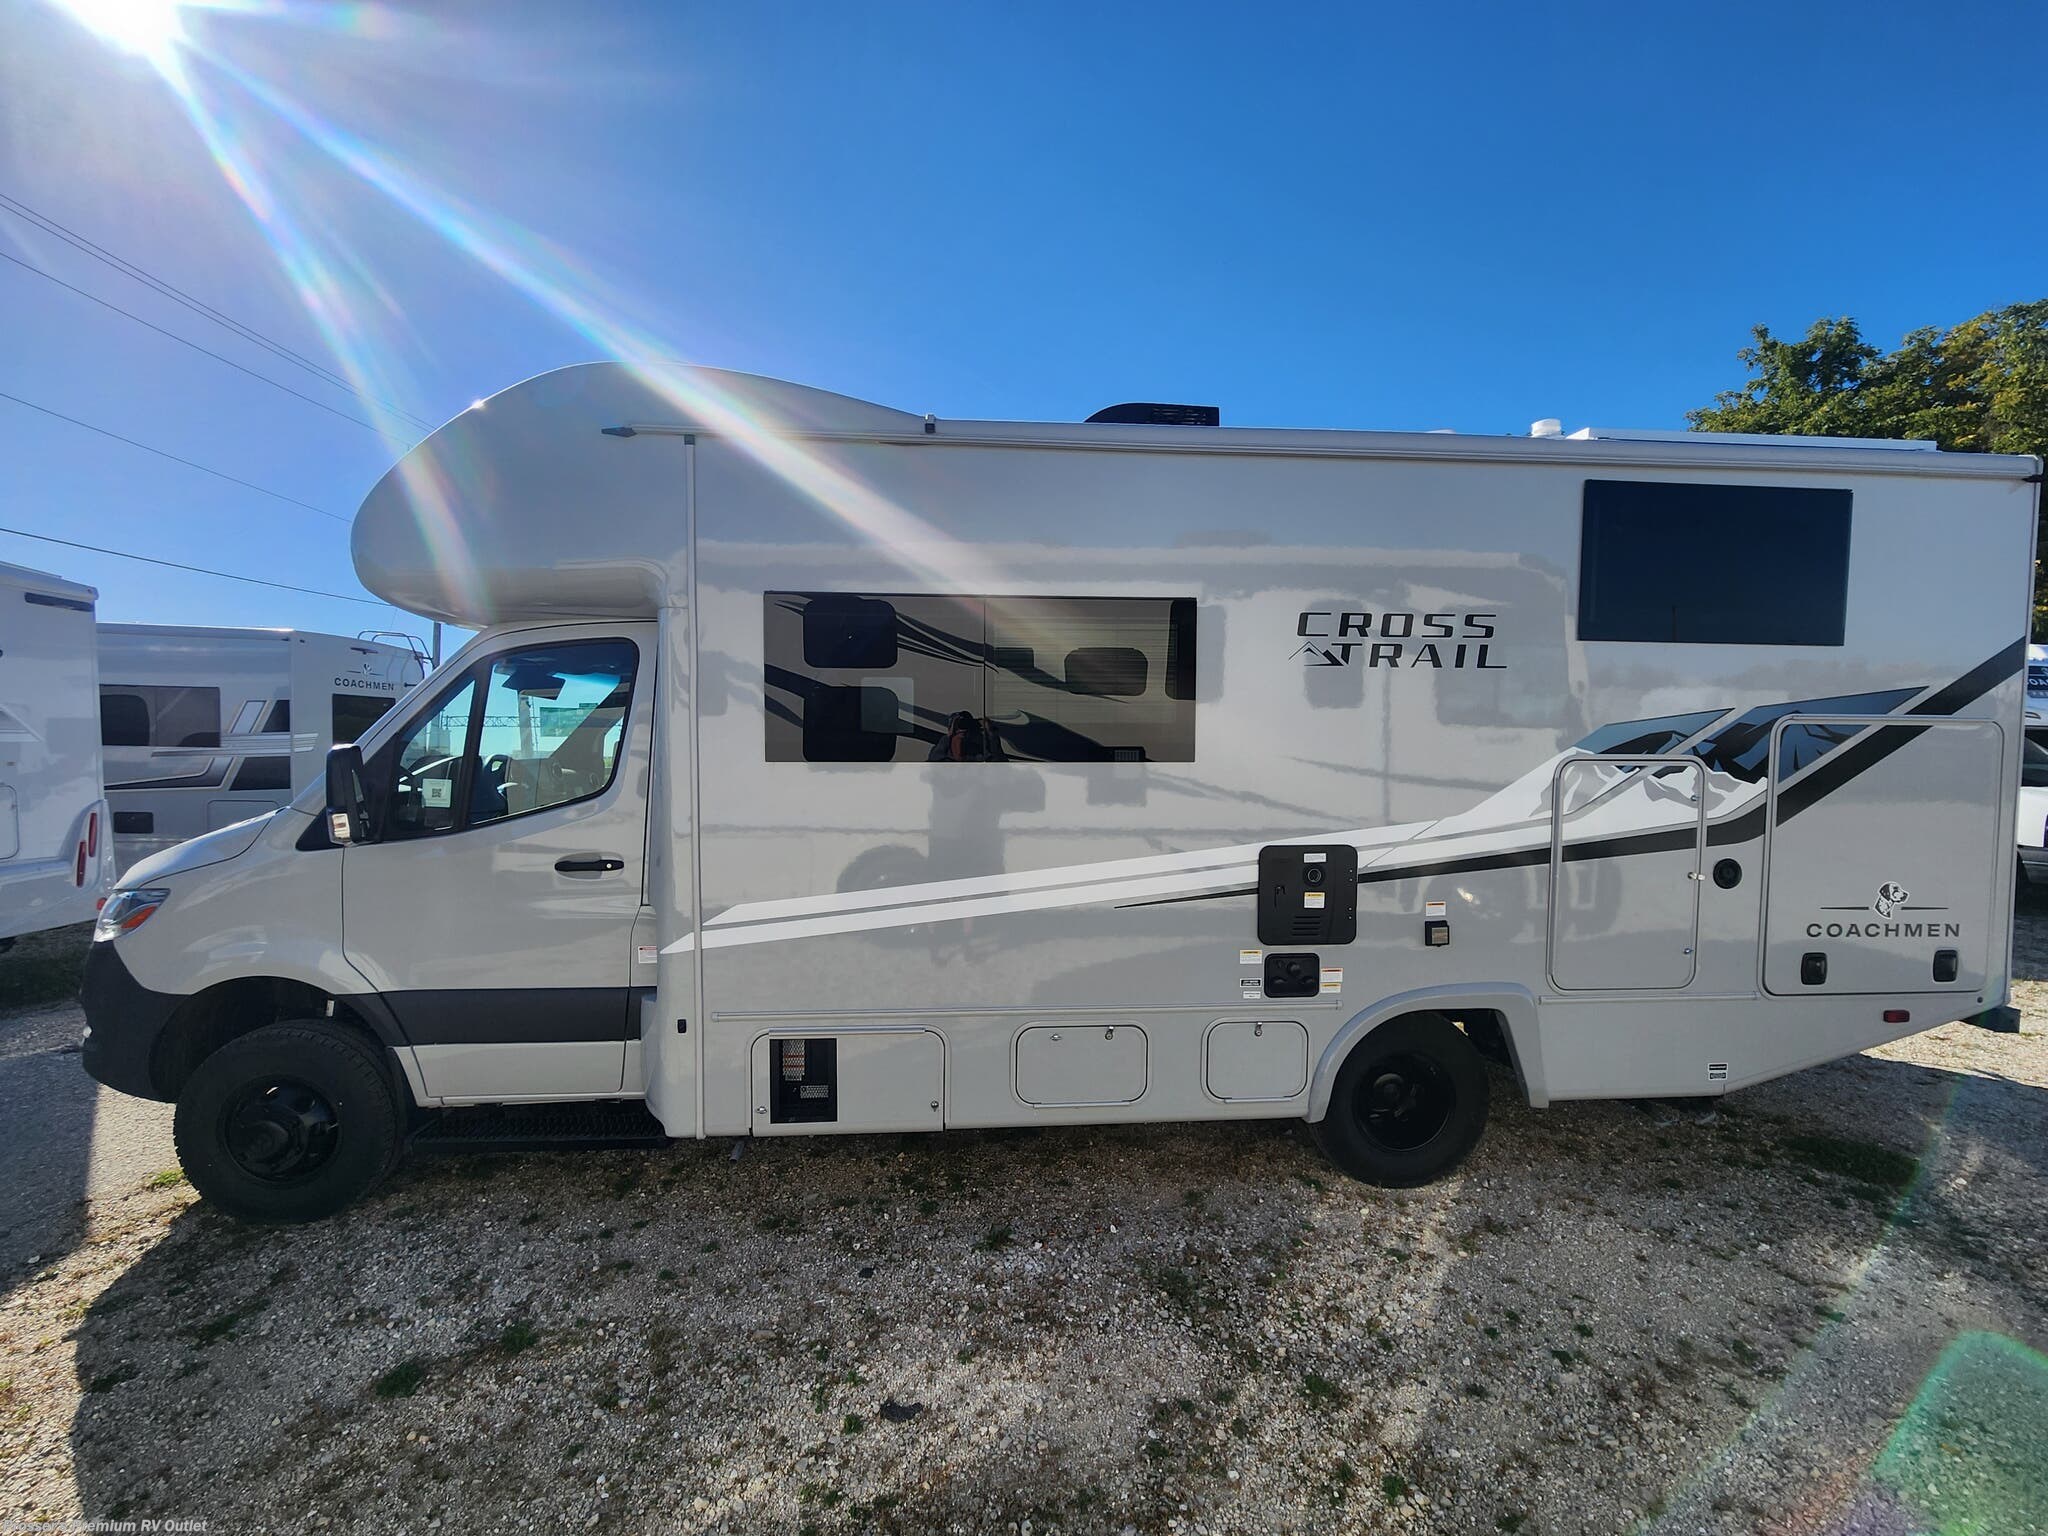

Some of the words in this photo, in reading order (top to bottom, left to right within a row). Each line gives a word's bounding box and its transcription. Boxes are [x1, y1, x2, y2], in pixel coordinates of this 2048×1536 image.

[1297, 612, 1497, 639] CROSS
[1331, 643, 1507, 668] TRAIL
[334, 677, 394, 691] COACHMEN
[1806, 923, 1960, 938] COACHMEN
